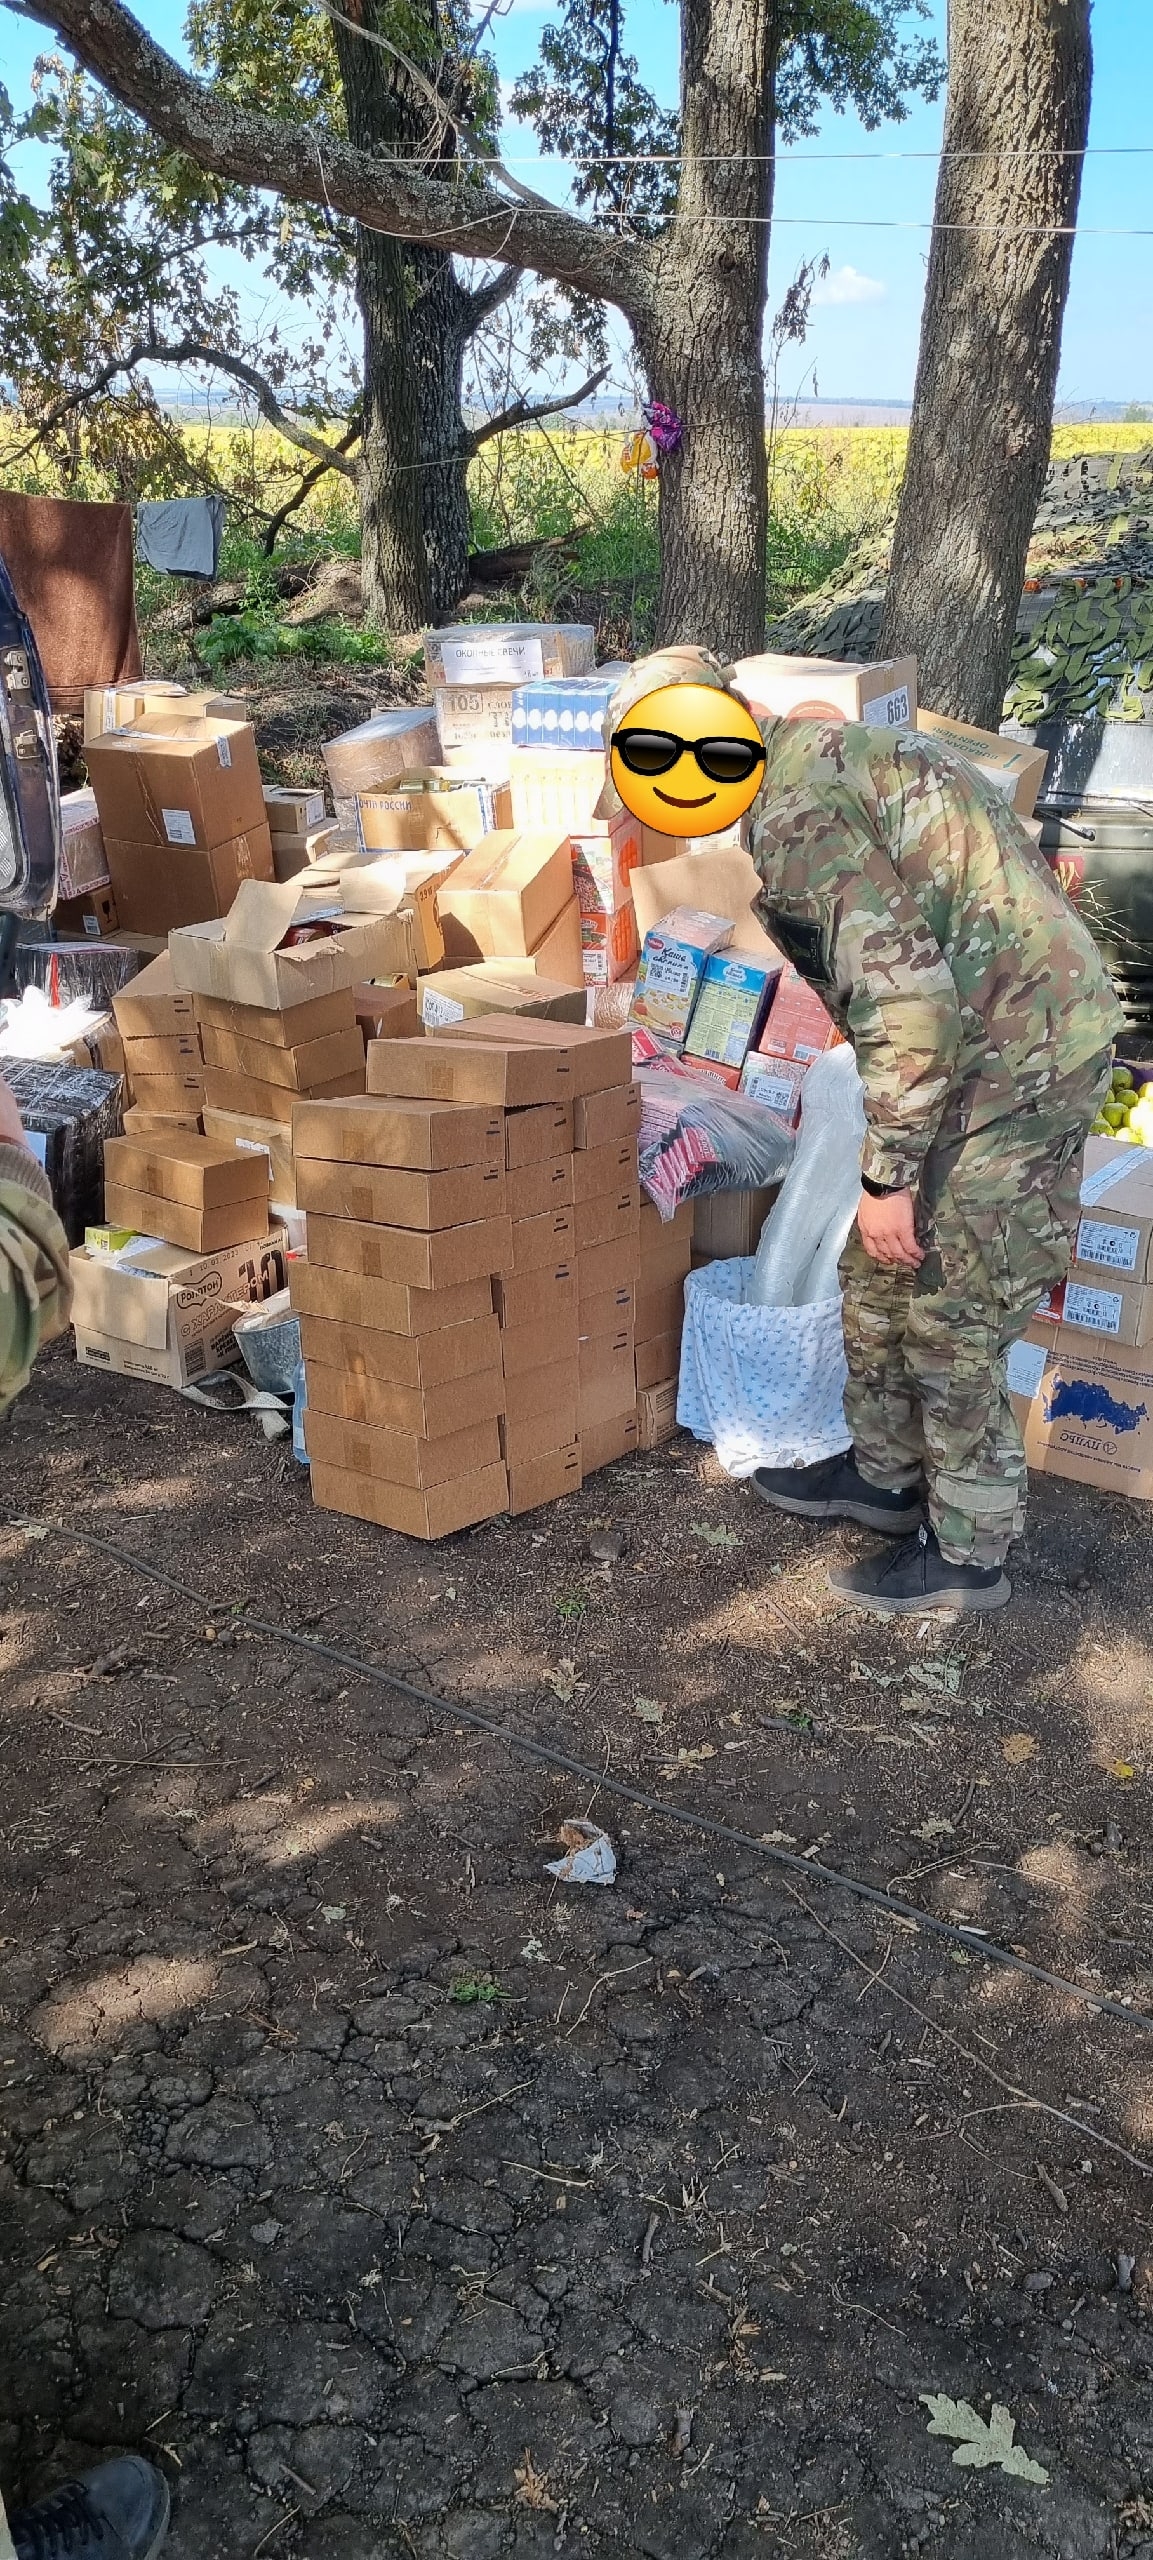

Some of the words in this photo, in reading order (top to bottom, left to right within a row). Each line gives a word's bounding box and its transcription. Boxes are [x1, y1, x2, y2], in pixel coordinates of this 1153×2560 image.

[446, 694, 480, 712] 105
[887, 693, 908, 725] 663
[1060, 1432, 1101, 1450] ПУЛЬС
